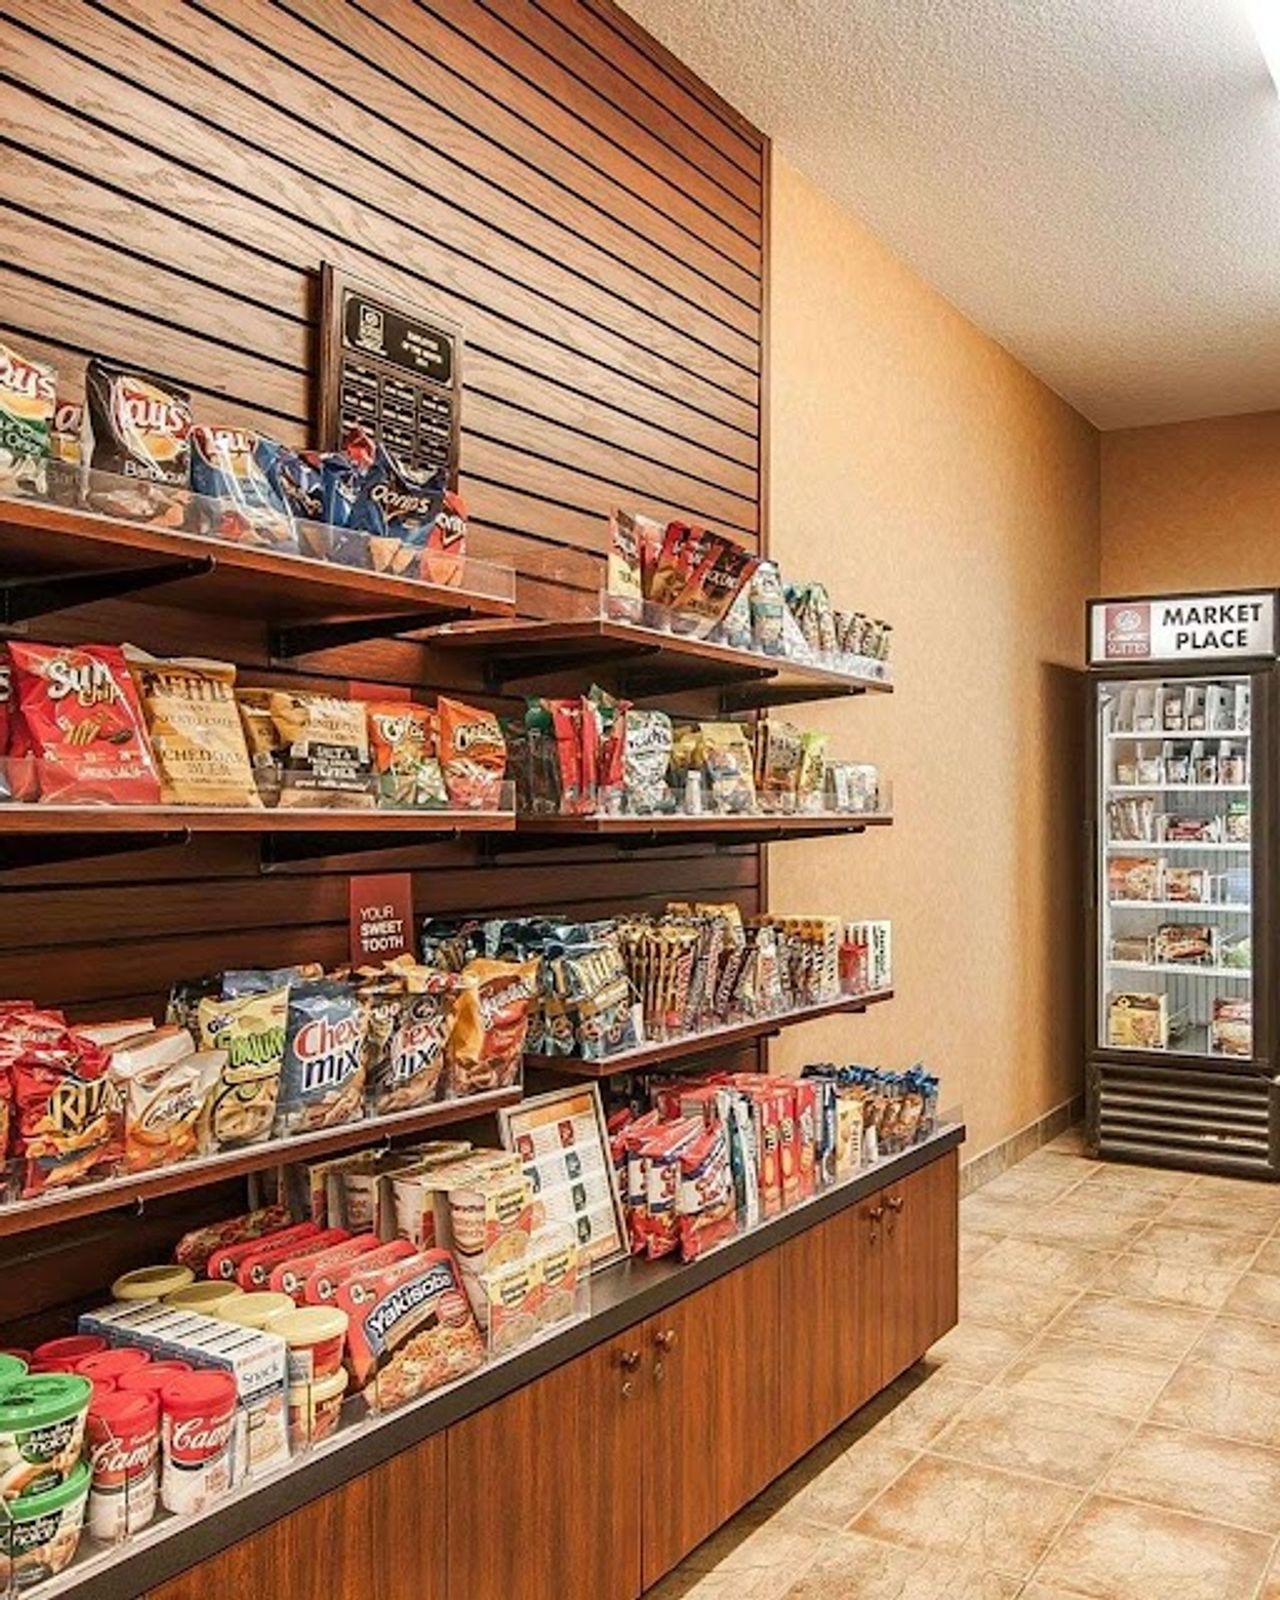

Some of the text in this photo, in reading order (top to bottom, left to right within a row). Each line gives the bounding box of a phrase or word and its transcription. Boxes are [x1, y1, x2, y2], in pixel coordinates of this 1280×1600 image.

[1162, 603, 1263, 627] MARKET
[1176, 629, 1248, 650] PLACE
[360, 905, 394, 920] YOUR
[360, 920, 404, 936] SWEET
[361, 936, 404, 952] TOOTH
[294, 1017, 360, 1060] Chex
[304, 1041, 360, 1090] mix
[368, 1273, 453, 1338] Yakisoba
